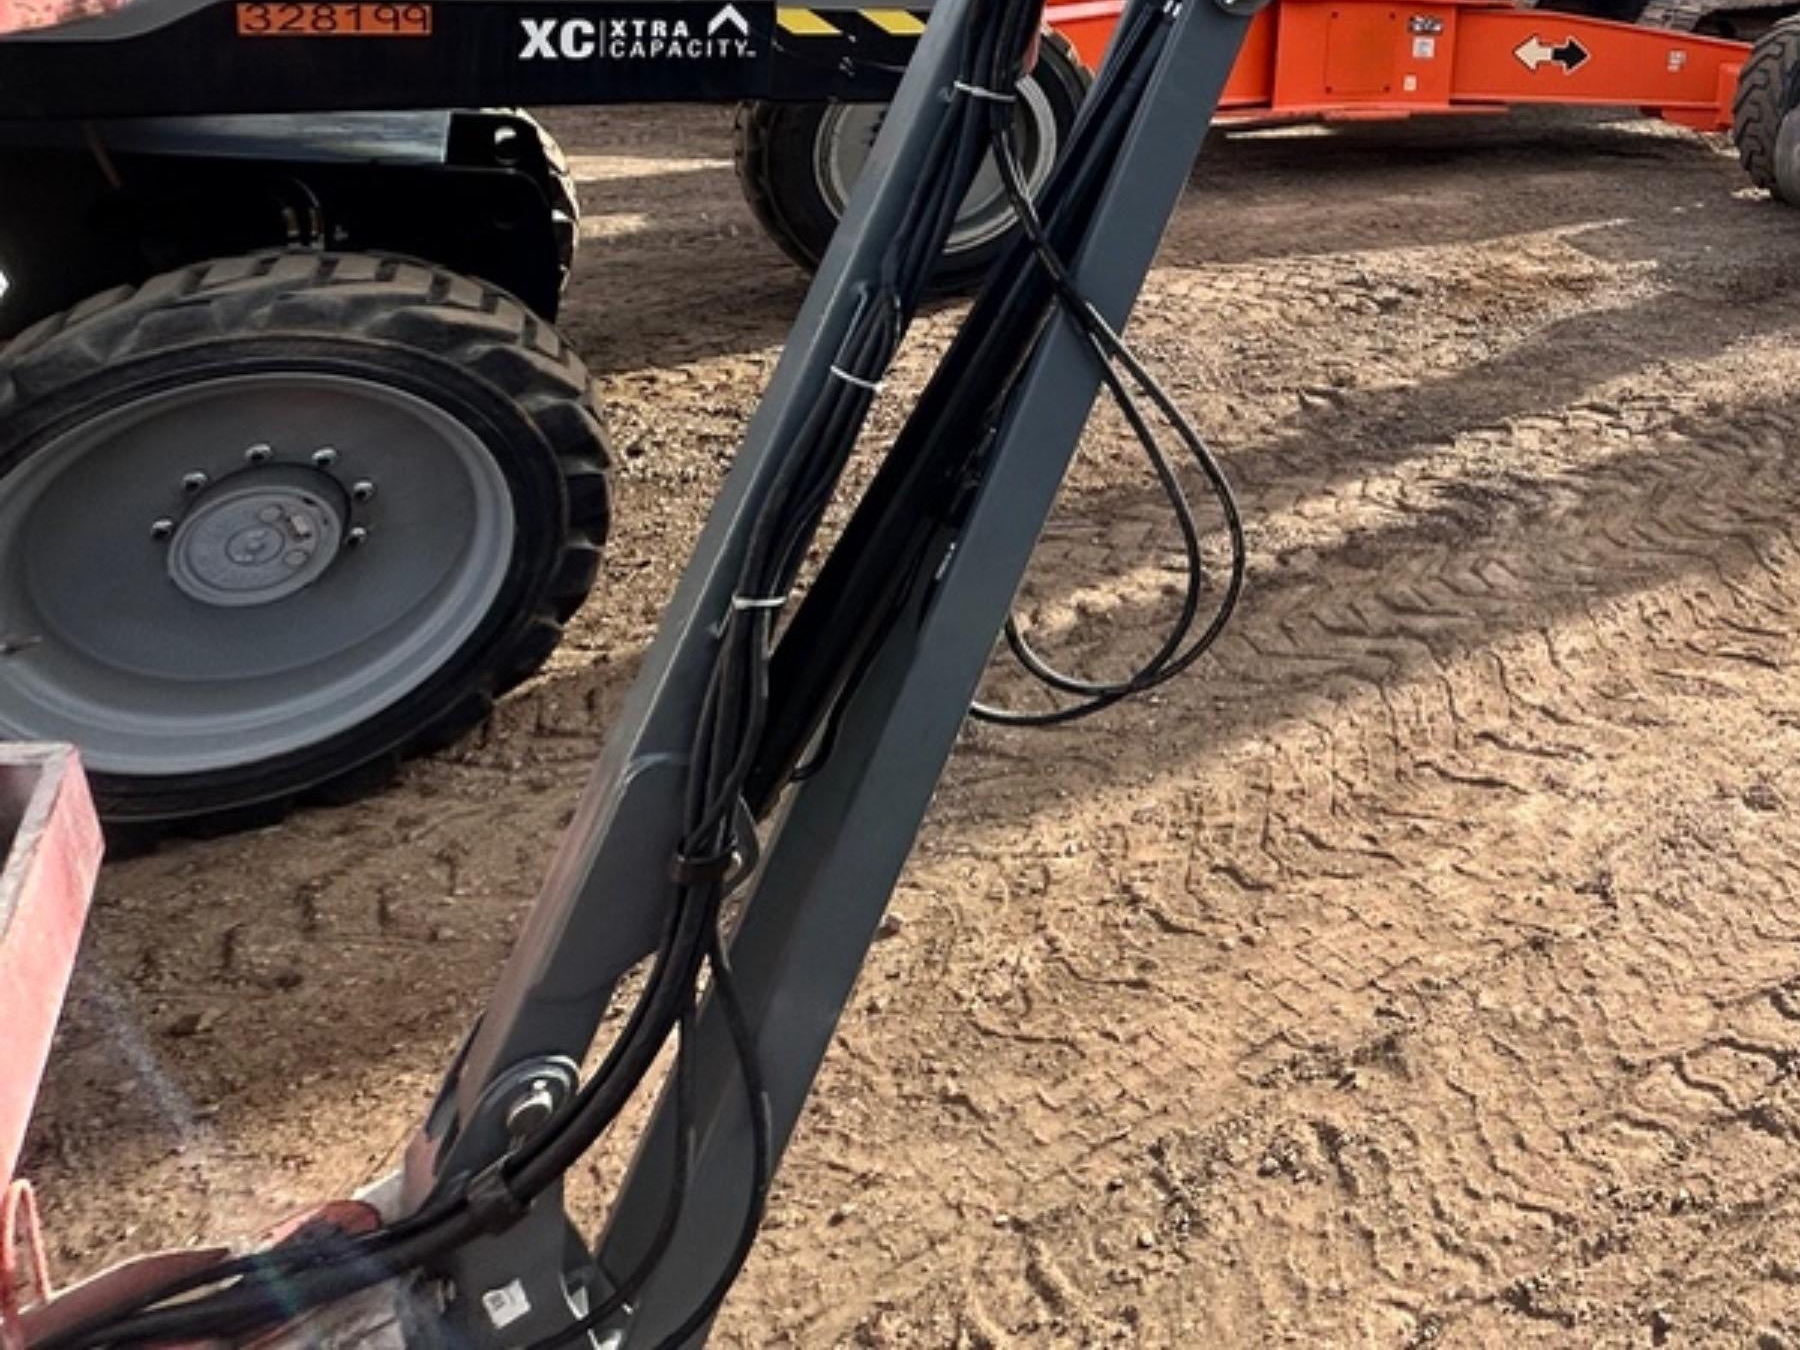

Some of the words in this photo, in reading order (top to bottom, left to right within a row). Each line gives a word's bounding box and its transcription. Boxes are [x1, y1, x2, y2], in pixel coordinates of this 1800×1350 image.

[243, 3, 431, 34] 328199
[610, 19, 690, 38] XTRA
[519, 17, 596, 60] XC
[609, 38, 749, 59] CAPACITY
